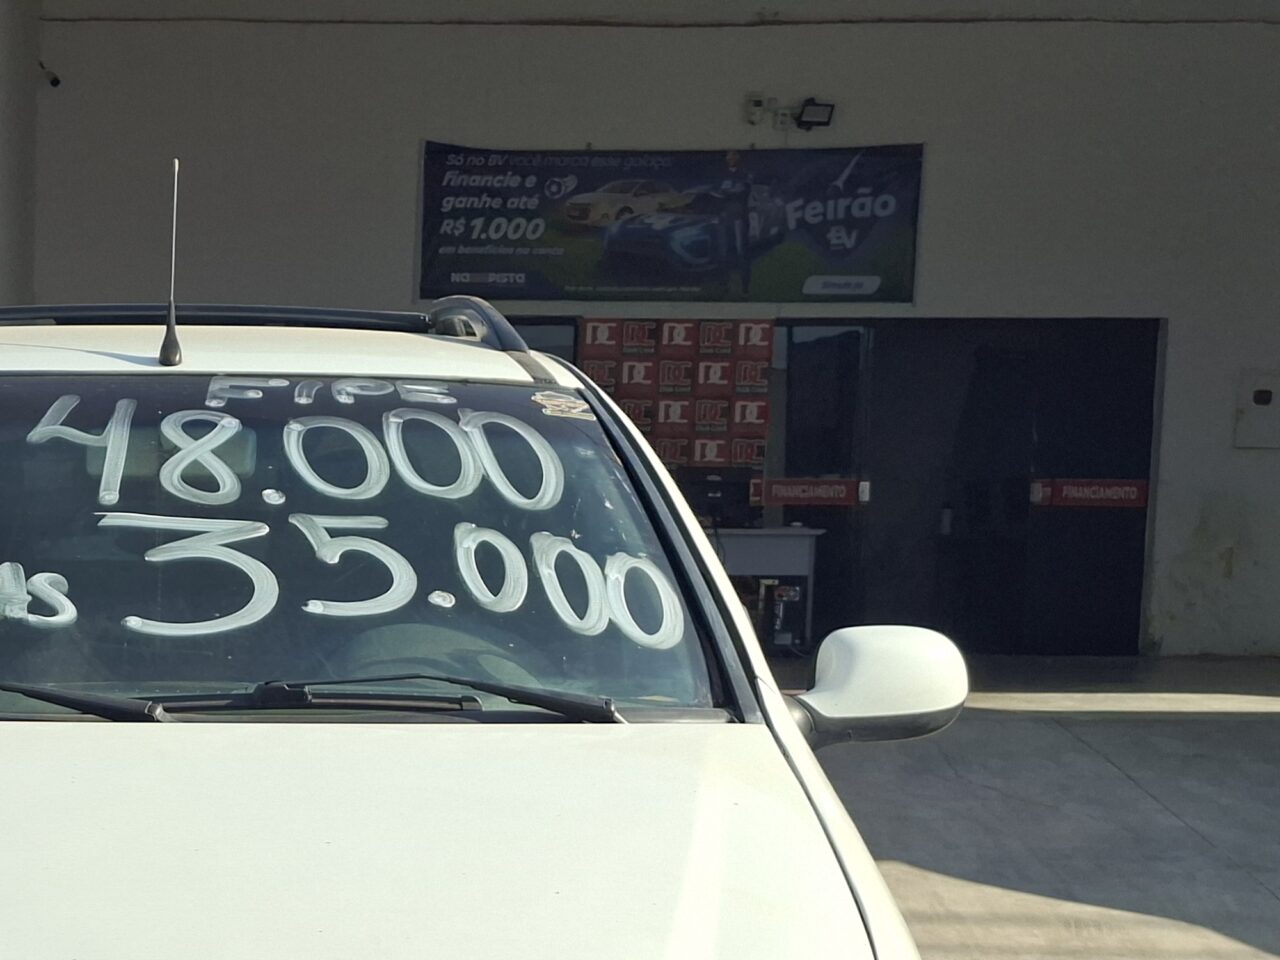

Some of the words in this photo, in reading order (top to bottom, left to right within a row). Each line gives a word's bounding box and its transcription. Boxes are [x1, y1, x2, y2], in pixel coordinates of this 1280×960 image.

[445, 153, 464, 167] Só
[465, 156, 486, 167] no
[522, 174, 538, 188] e
[440, 192, 503, 213] ganhe
[506, 194, 539, 210] até
[785, 187, 897, 231] Feirão
[439, 217, 465, 237] R$
[469, 217, 546, 241] 1.000
[26, 394, 564, 511] 48.000
[94, 511, 684, 649] 35.000
